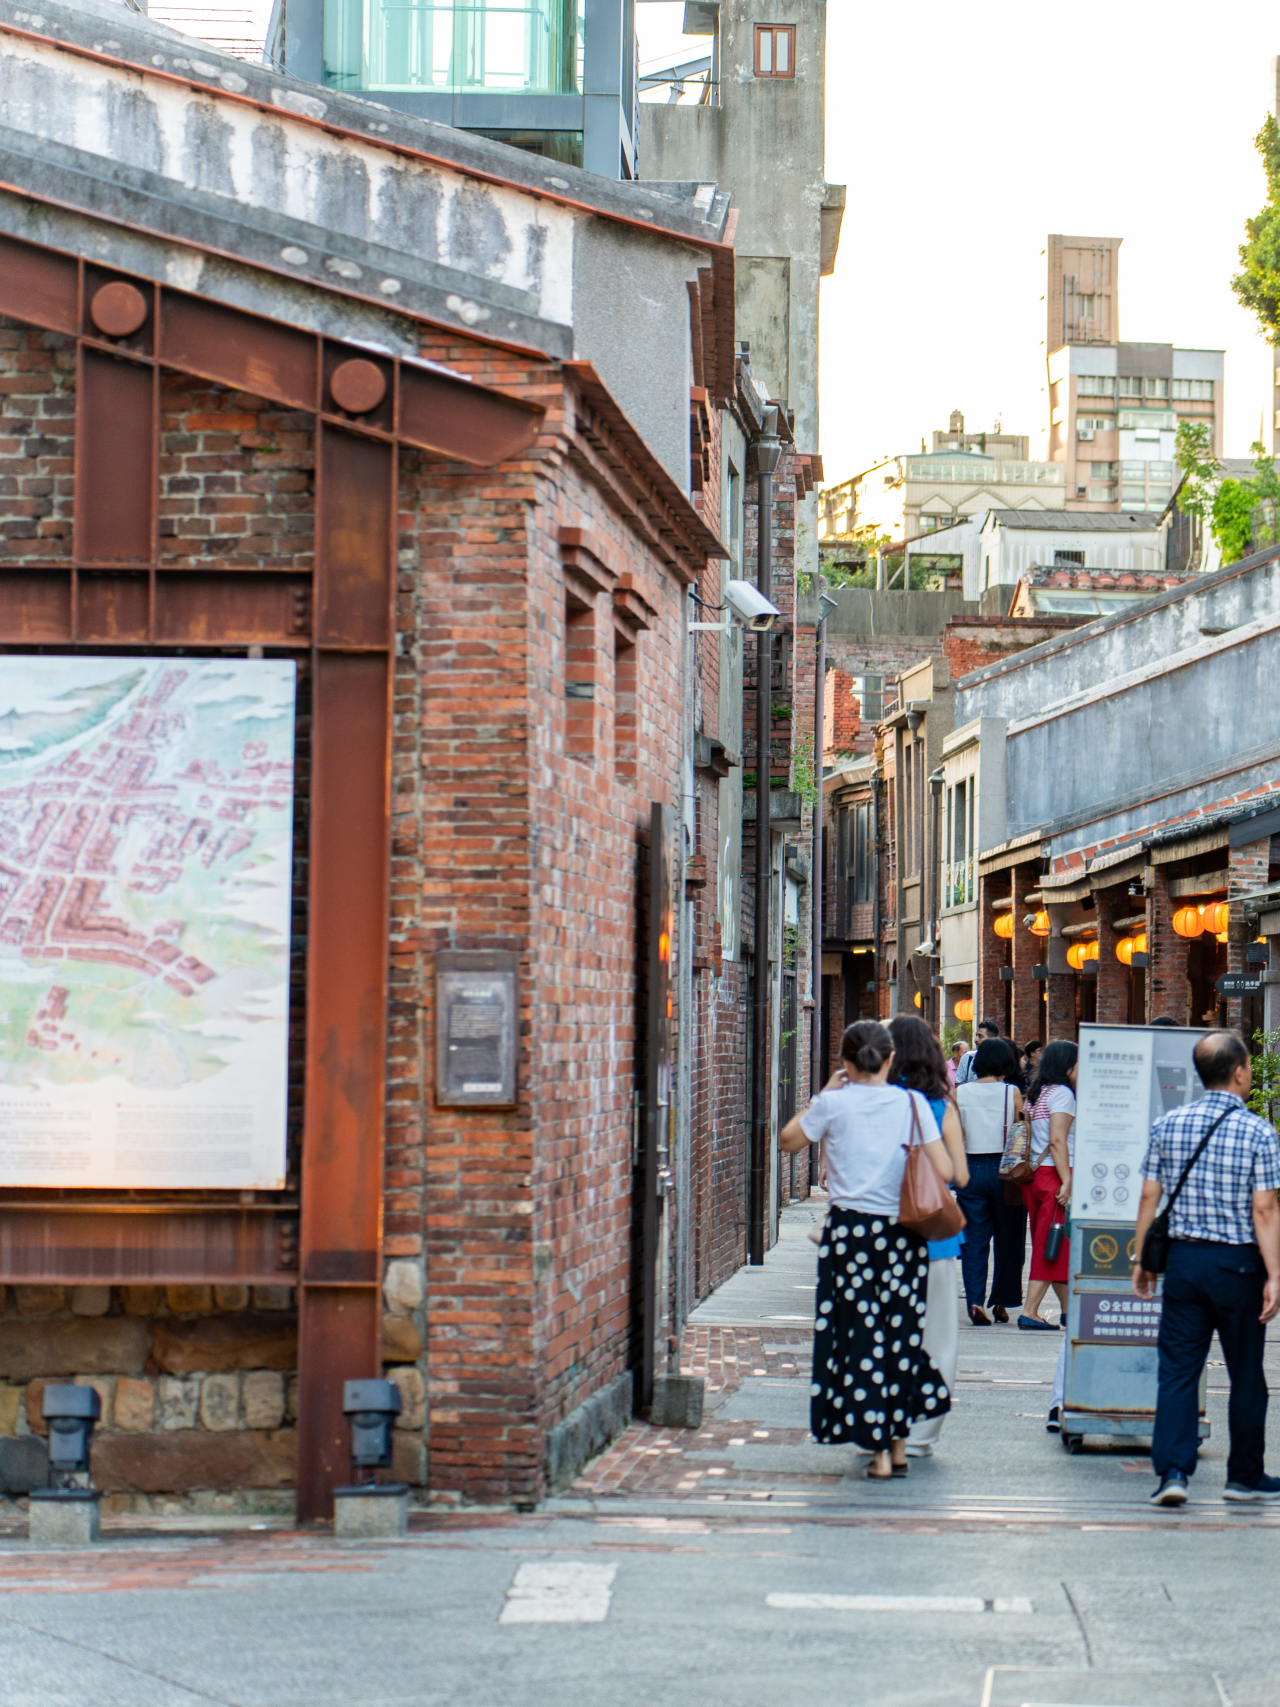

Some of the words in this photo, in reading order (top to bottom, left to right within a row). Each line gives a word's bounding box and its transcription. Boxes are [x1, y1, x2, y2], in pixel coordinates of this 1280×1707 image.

[1094, 1314, 1161, 1325] 汽機車及腳踏車禁
